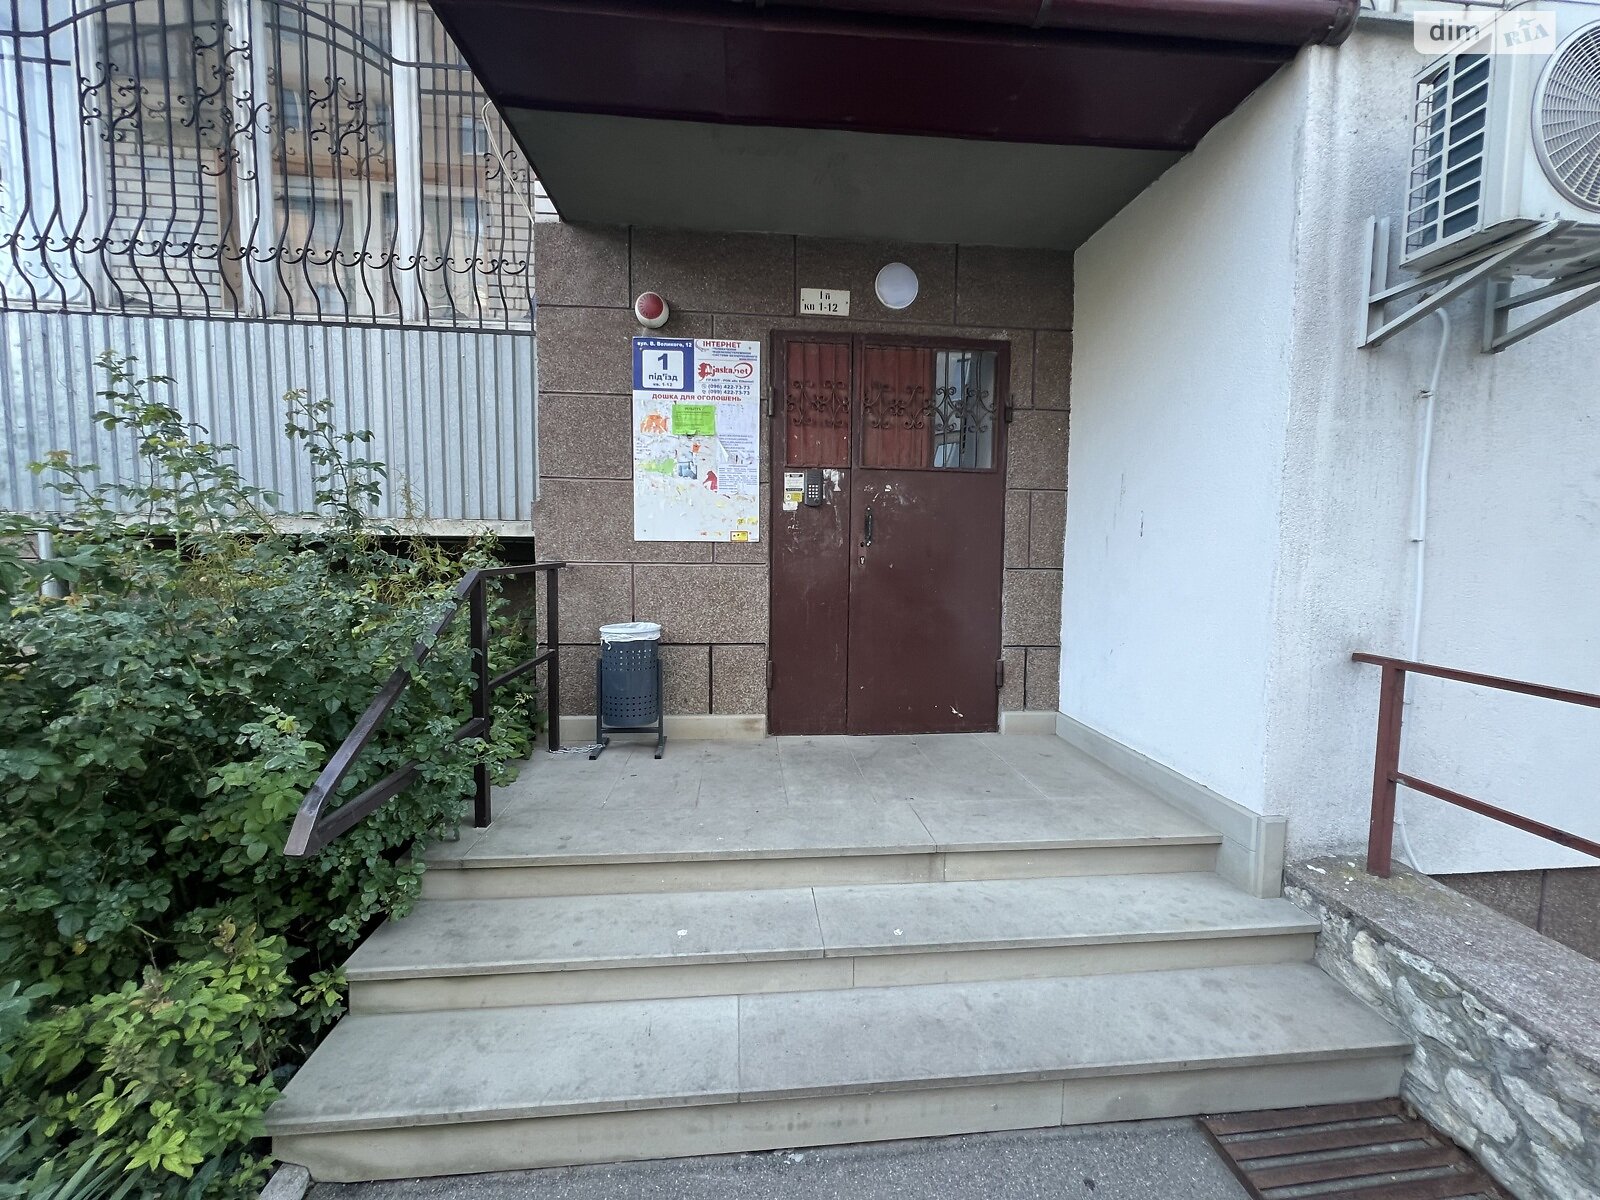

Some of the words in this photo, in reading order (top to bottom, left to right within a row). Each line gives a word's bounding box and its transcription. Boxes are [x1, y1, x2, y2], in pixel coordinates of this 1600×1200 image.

[820, 302, 838, 312] 1-12
[703, 340, 741, 348] ІНТЕРНЕТ
[657, 353, 668, 370] 1
[648, 372, 678, 382] під'їзд
[652, 393, 679, 401] ДОШКА
[696, 394, 742, 402] ОГОЛОШЕНЬ
